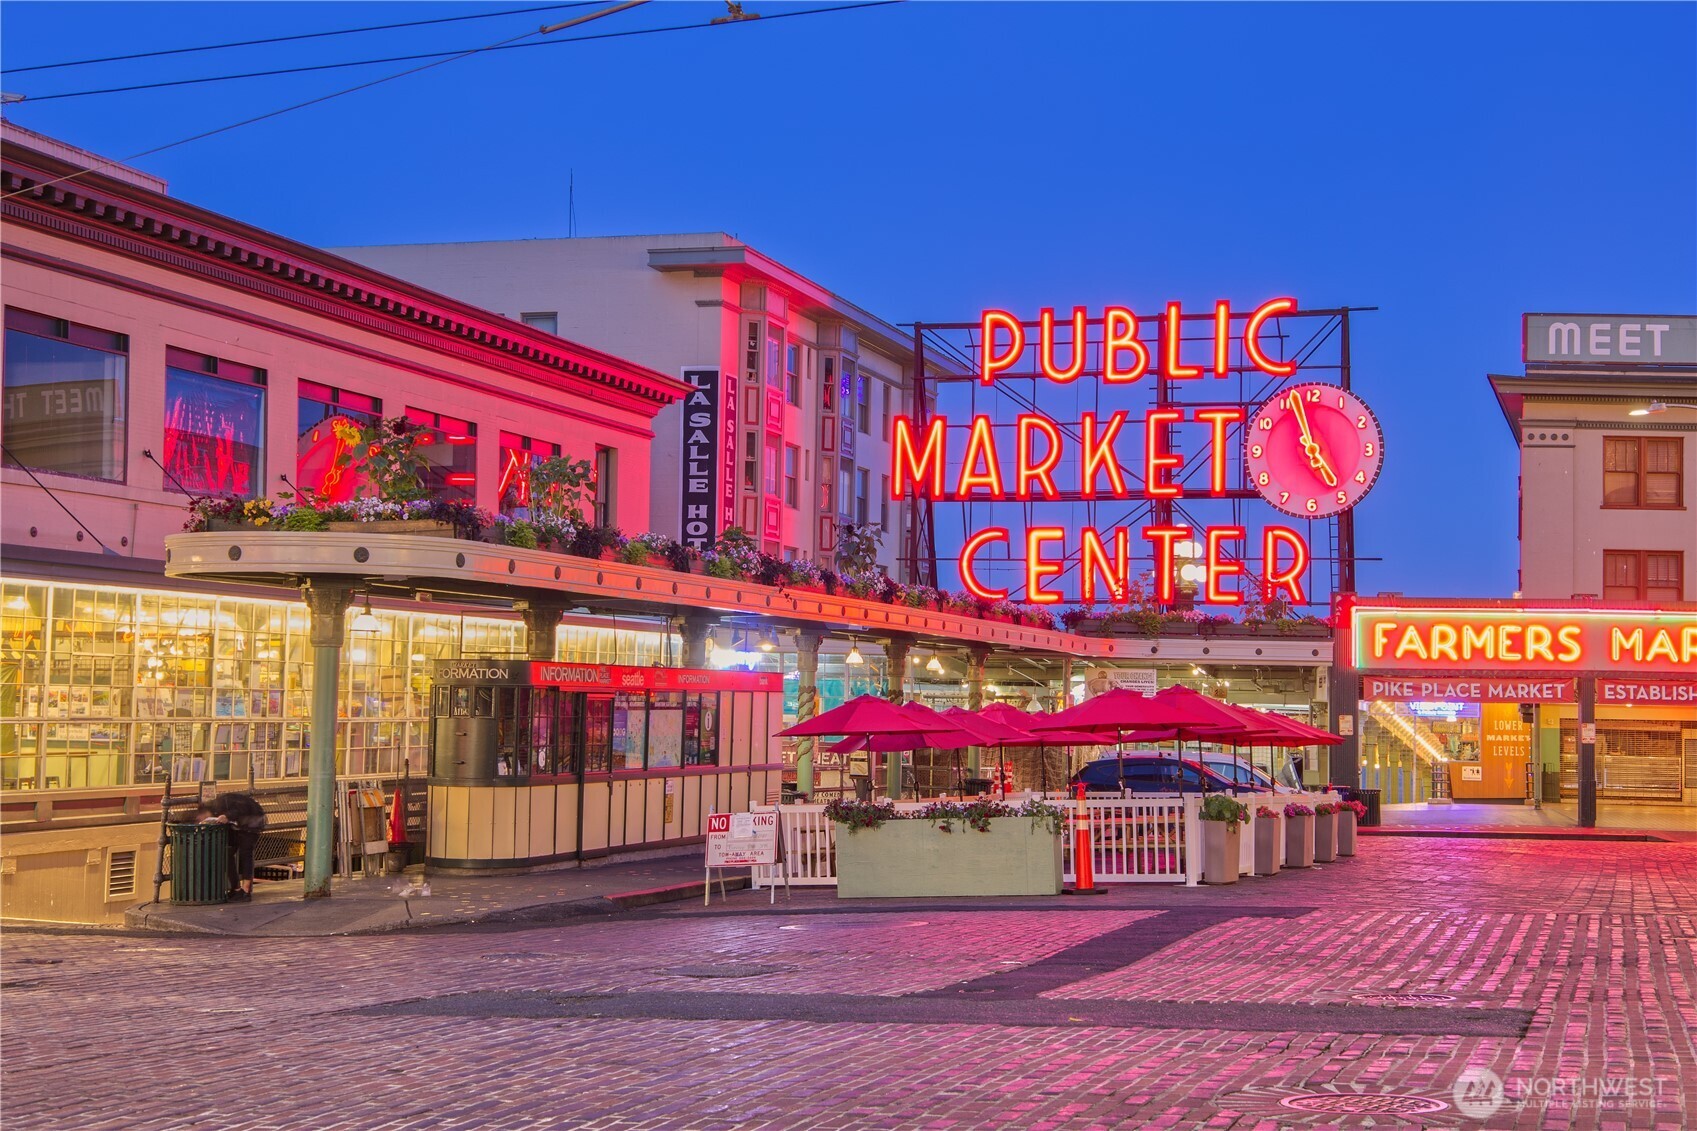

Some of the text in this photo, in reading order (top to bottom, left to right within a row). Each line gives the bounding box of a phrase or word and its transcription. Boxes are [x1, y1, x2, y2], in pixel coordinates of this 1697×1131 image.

[981, 297, 1298, 387] PUBLIC
[1548, 322, 1670, 356] MEET
[688, 375, 711, 405] LA
[726, 379, 735, 411] LA
[1307, 389, 1321, 402] 12
[1338, 396, 1344, 409] 1
[1259, 417, 1272, 430] 10
[1357, 415, 1367, 428] 2
[687, 412, 711, 492] SALLE
[891, 407, 1246, 502] MARKET
[1251, 445, 1262, 458] 9
[1364, 443, 1374, 456] 3
[725, 419, 734, 498] SALLE
[1258, 472, 1269, 485] 8
[1354, 470, 1365, 483] 4
[1280, 492, 1289, 504] 7
[1337, 491, 1347, 504] 5
[1306, 498, 1317, 512] 6
[957, 526, 1311, 607] CENTER
[1373, 622, 1582, 662] FARMERS
[438, 668, 509, 679] FORMATION
[540, 666, 599, 683] INFORMATION
[621, 670, 645, 687] seattle
[678, 674, 710, 685] INFORMATION
[1372, 681, 1565, 699] PIKE PLACE MARKET
[1494, 720, 1523, 731] LOWER
[1486, 734, 1531, 742] MARKET
[1493, 746, 1525, 756] LEVELS
[711, 817, 727, 830] NO
